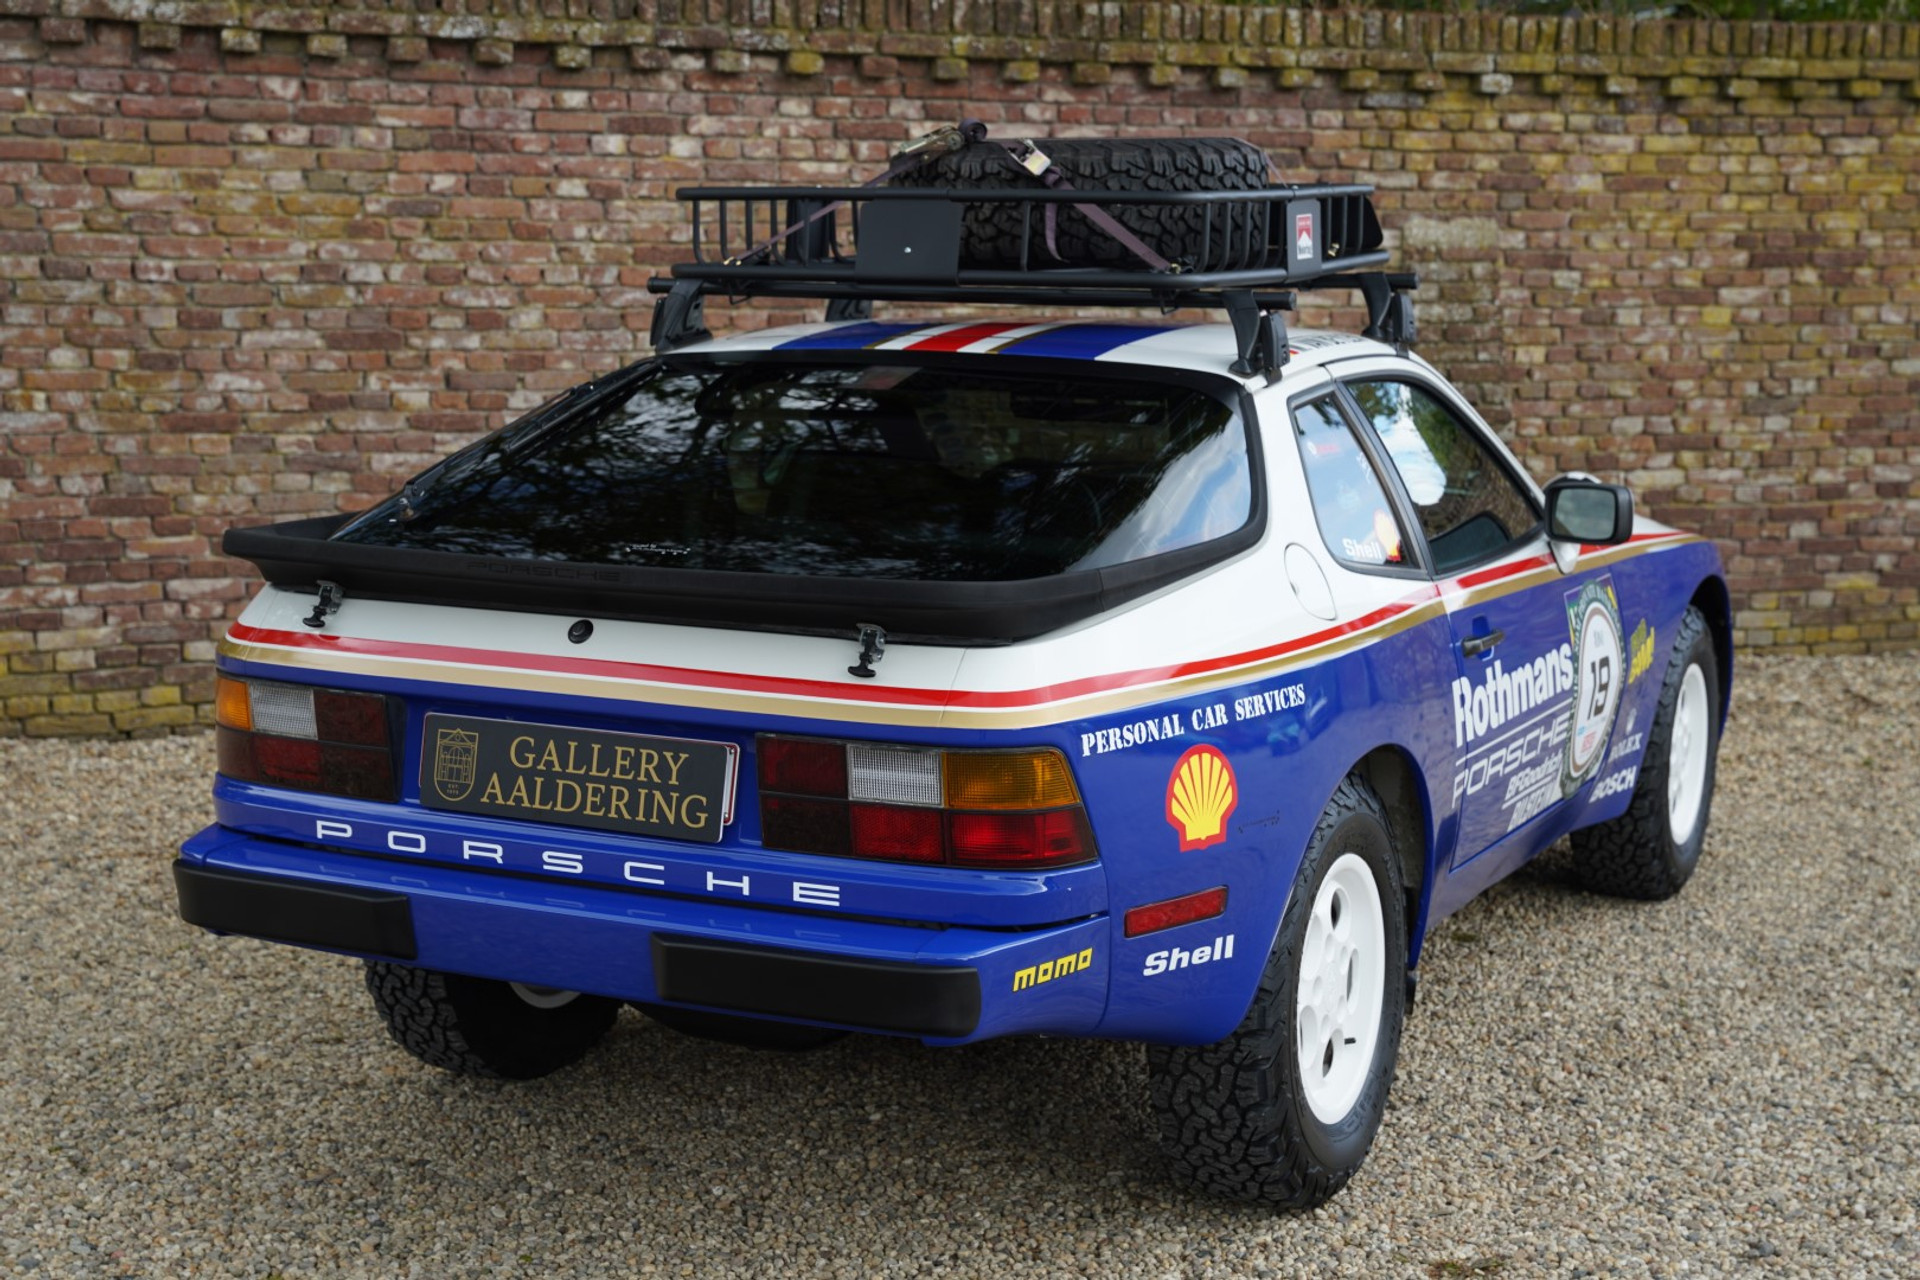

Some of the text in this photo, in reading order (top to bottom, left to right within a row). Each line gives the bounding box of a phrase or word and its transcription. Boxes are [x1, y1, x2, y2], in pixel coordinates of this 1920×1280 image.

[466, 561, 620, 582] PORSCHE
[1342, 537, 1382, 559] Shell
[1452, 643, 1573, 748] Rothmans
[1587, 656, 1610, 720] 19
[1081, 683, 1305, 757] PERSONAL CAR SERVICES
[510, 735, 689, 785] GALLERY
[1452, 710, 1571, 809] PORSCHE
[1589, 766, 1637, 803] BOSCH
[481, 772, 708, 829] AALDERING
[316, 820, 840, 907] PORSCHE
[1143, 934, 1235, 976] Shell
